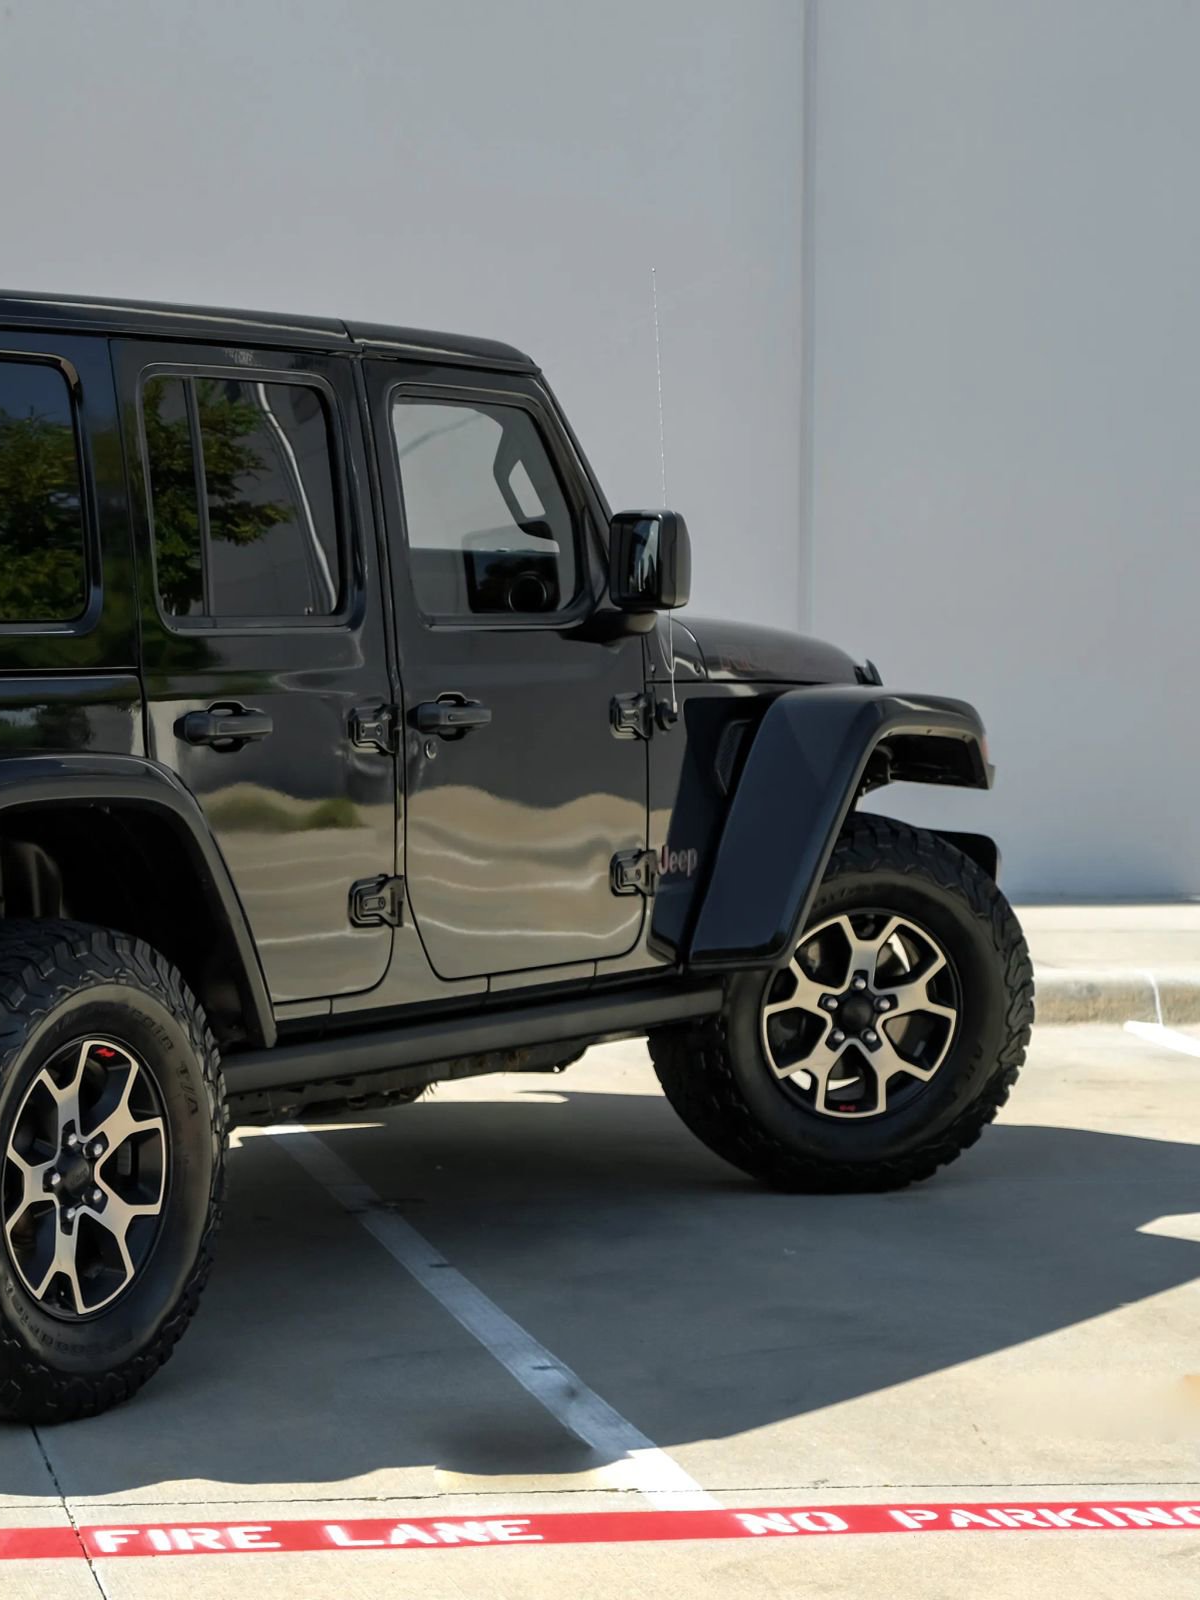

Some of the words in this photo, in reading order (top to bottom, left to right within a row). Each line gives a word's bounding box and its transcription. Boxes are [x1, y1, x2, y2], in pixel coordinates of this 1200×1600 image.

[657, 845, 698, 876] Jeep
[97, 1527, 282, 1553] FIRE
[325, 1519, 543, 1546] LANE
[734, 1511, 849, 1534] NO
